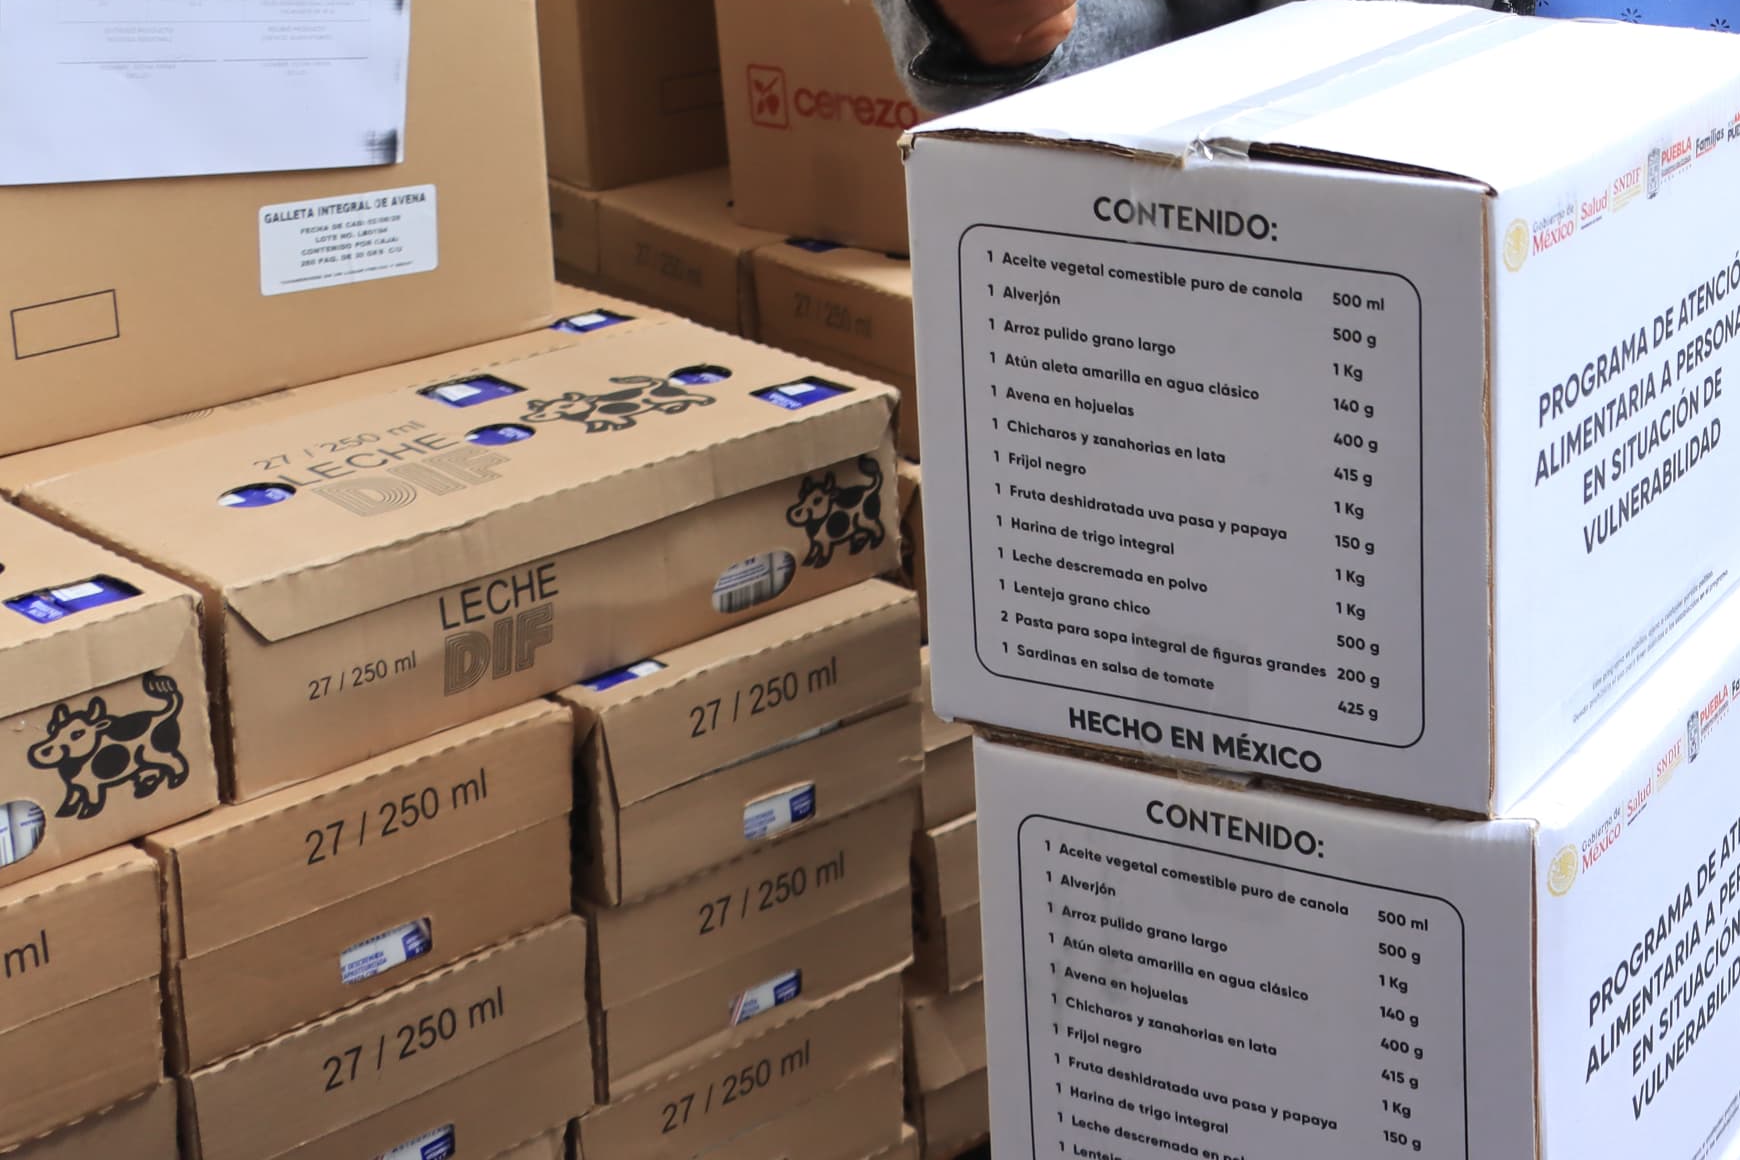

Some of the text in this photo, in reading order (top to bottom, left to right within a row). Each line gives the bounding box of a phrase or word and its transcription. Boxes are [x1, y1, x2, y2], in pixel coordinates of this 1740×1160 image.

[794, 88, 920, 130] cerezo
[264, 192, 427, 224] GALLETA INTEGRAL DE AVENA
[1093, 196, 1278, 242] CONTENIDO:
[1532, 218, 1575, 257] México
[1580, 192, 1608, 222] Salud
[1613, 166, 1642, 196] SNDIF
[1661, 136, 1692, 167] PUEBLA
[1695, 126, 1724, 154] Familias
[986, 250, 1385, 311] 1 Aceite vegetal comestible puro de canola 500 ml
[987, 283, 1377, 349] 1 Alverjón 500 g
[988, 317, 1363, 383] 1 Arroz pulido grano largo 1 Kg
[989, 351, 1374, 419] 1 Atún aleta amarilla en agua clásico 140 g
[1539, 326, 1649, 429] PROGRAMA
[1653, 306, 1674, 349] DE
[1534, 371, 1657, 487] ALIMENTARIA
[1660, 359, 1673, 394] A
[1583, 366, 1722, 505] EN SITUACIÓN DE
[278, 432, 459, 488] LECHE
[311, 444, 510, 517] DIF
[1583, 417, 1721, 555] VULNERABILIDAD
[438, 562, 560, 631] LECHE
[308, 650, 417, 701] 27 / 250 ml
[443, 601, 554, 697] DIF
[689, 655, 837, 739] 27 / 250 ml
[1068, 706, 1322, 773] HECHO EN MÉXICO
[1581, 822, 1622, 874] México
[1626, 777, 1652, 817] Salud
[1656, 738, 1682, 778] SNDIF
[1699, 684, 1729, 725] PUEBLA
[305, 767, 487, 866] 27 / 250 ml
[1146, 799, 1324, 859] CONTENIDO:
[3, 928, 50, 979] ml
[1589, 882, 1693, 1028] PROGRAMA
[1697, 849, 1716, 898] DE
[1585, 919, 1701, 1084] ALIMENTARIA
[1704, 901, 1716, 936] A
[1632, 1024, 1654, 1077] EN
[1658, 909, 1740, 1041] SITUACIÓN
[322, 985, 504, 1093] 27 / 250 ml
